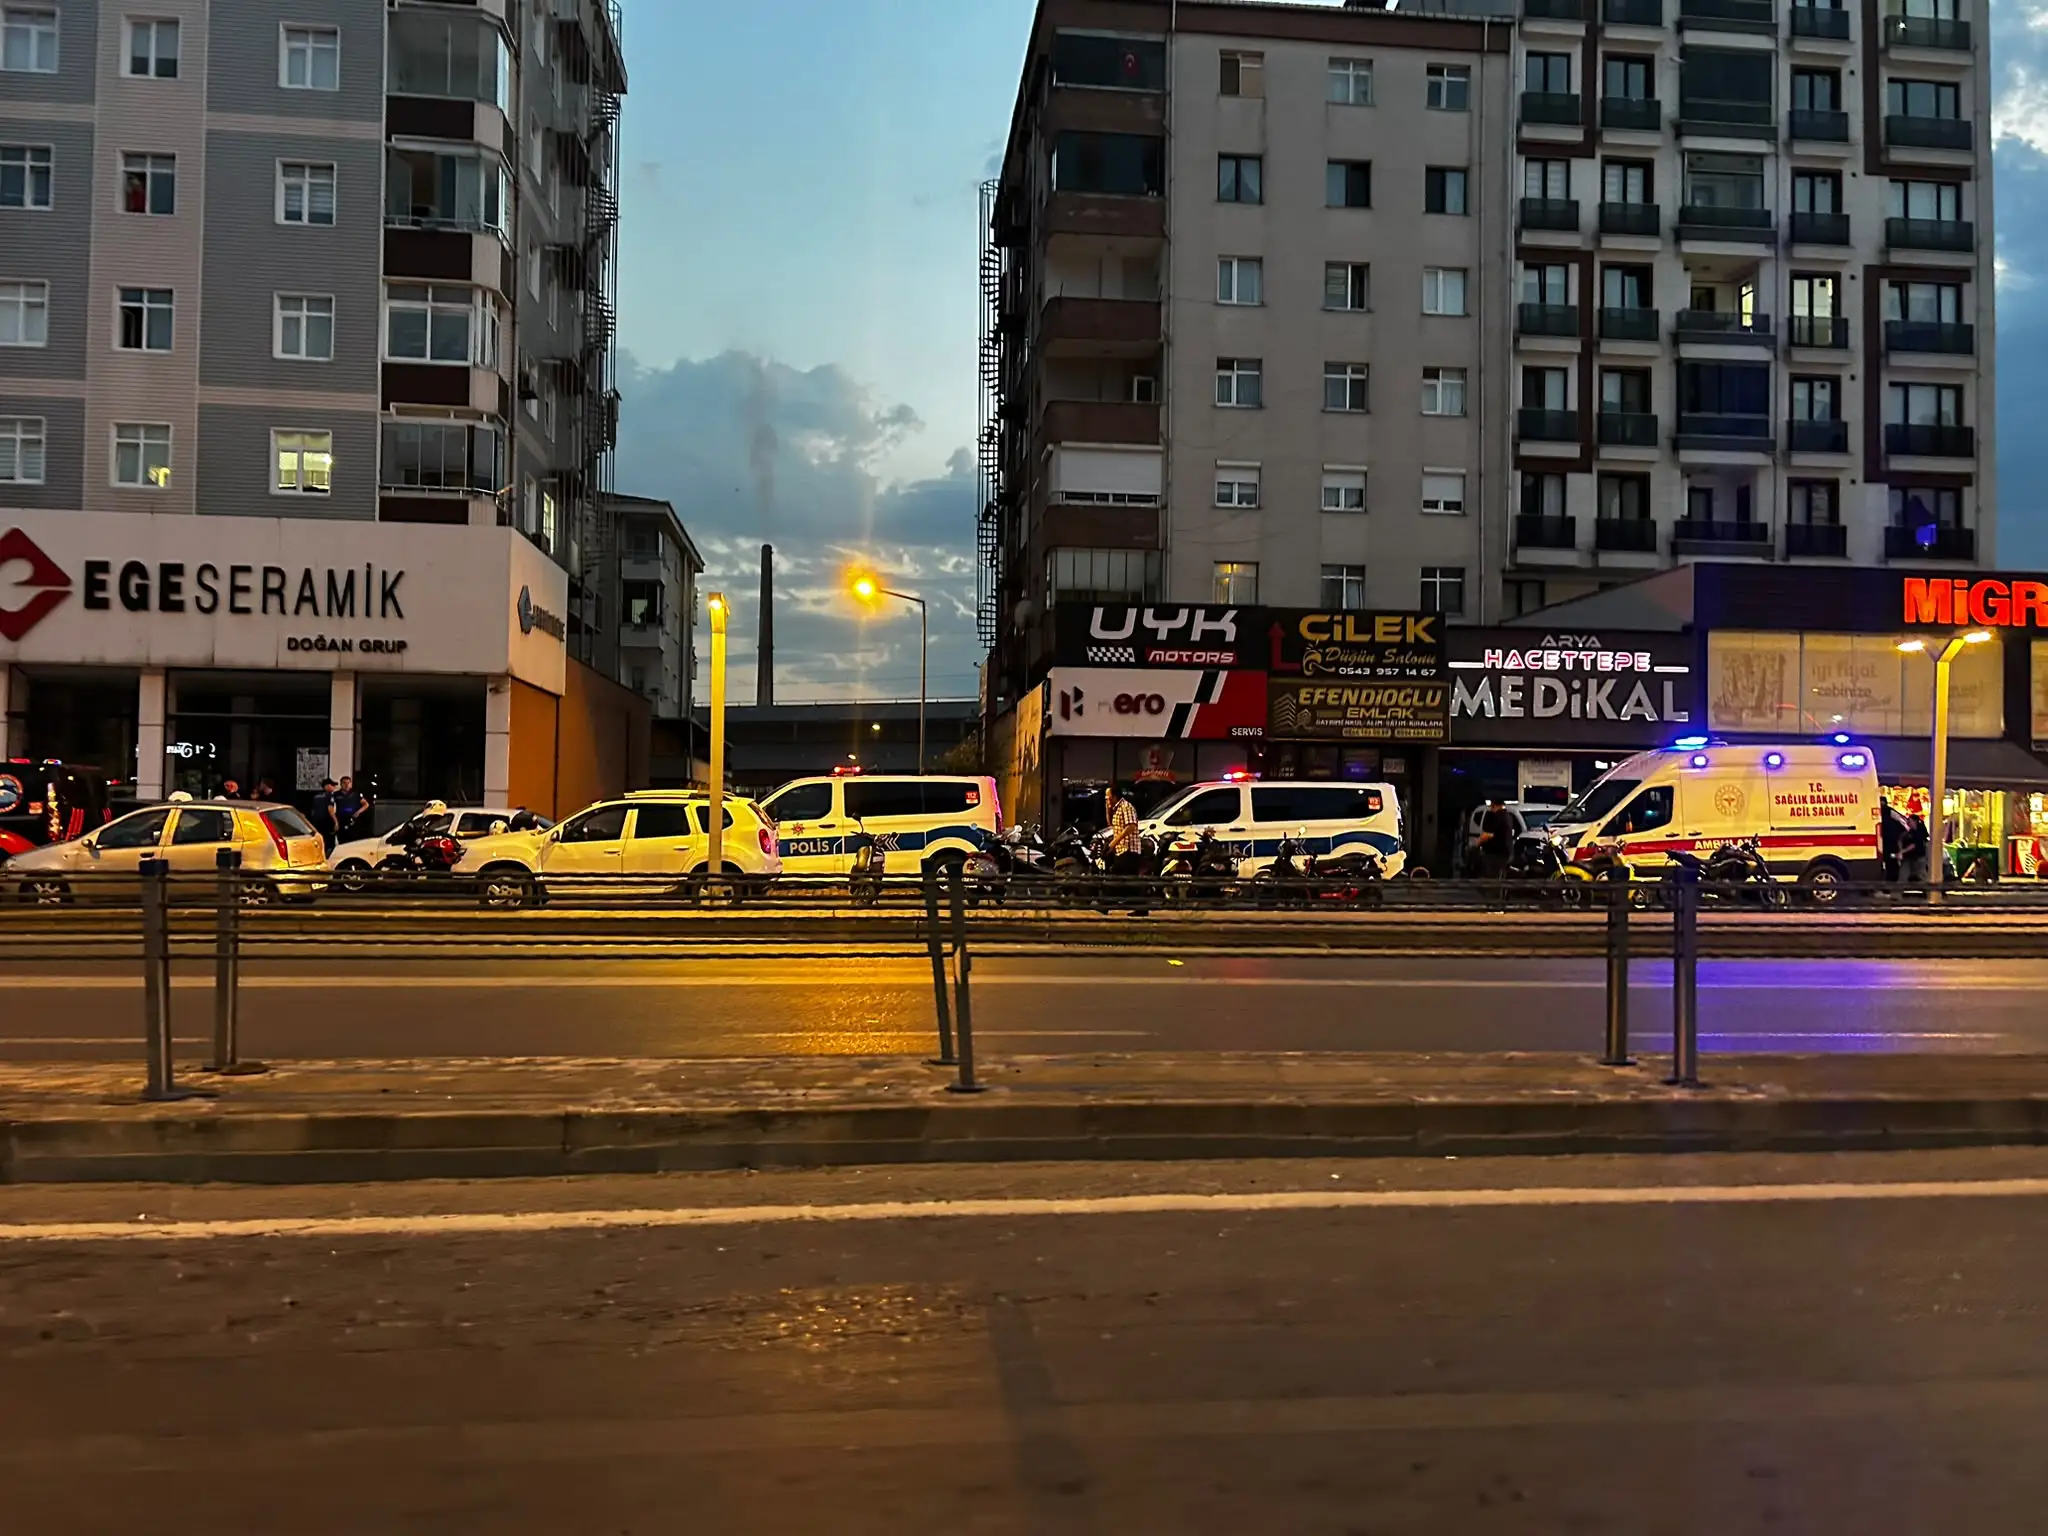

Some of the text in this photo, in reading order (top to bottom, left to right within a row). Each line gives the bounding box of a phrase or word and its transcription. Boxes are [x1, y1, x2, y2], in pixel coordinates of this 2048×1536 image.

[1089, 606, 1239, 642] UYK
[287, 634, 408, 654] DOĞAN GRUP
[1540, 634, 1602, 648] ARYA
[1148, 650, 1235, 663] MOTORS
[1382, 647, 1437, 665] Salonu
[1484, 649, 1651, 671] HACETTEPE
[1338, 667, 1437, 676] 0543 957 14 67
[1346, 707, 1414, 719] EMLAK
[1808, 782, 1826, 793] T.C.
[1775, 793, 1858, 805] SAĞLIK BAKANLIĞI
[1790, 805, 1845, 817] ACİL SAĞLIK
[789, 838, 830, 855] POLİS
